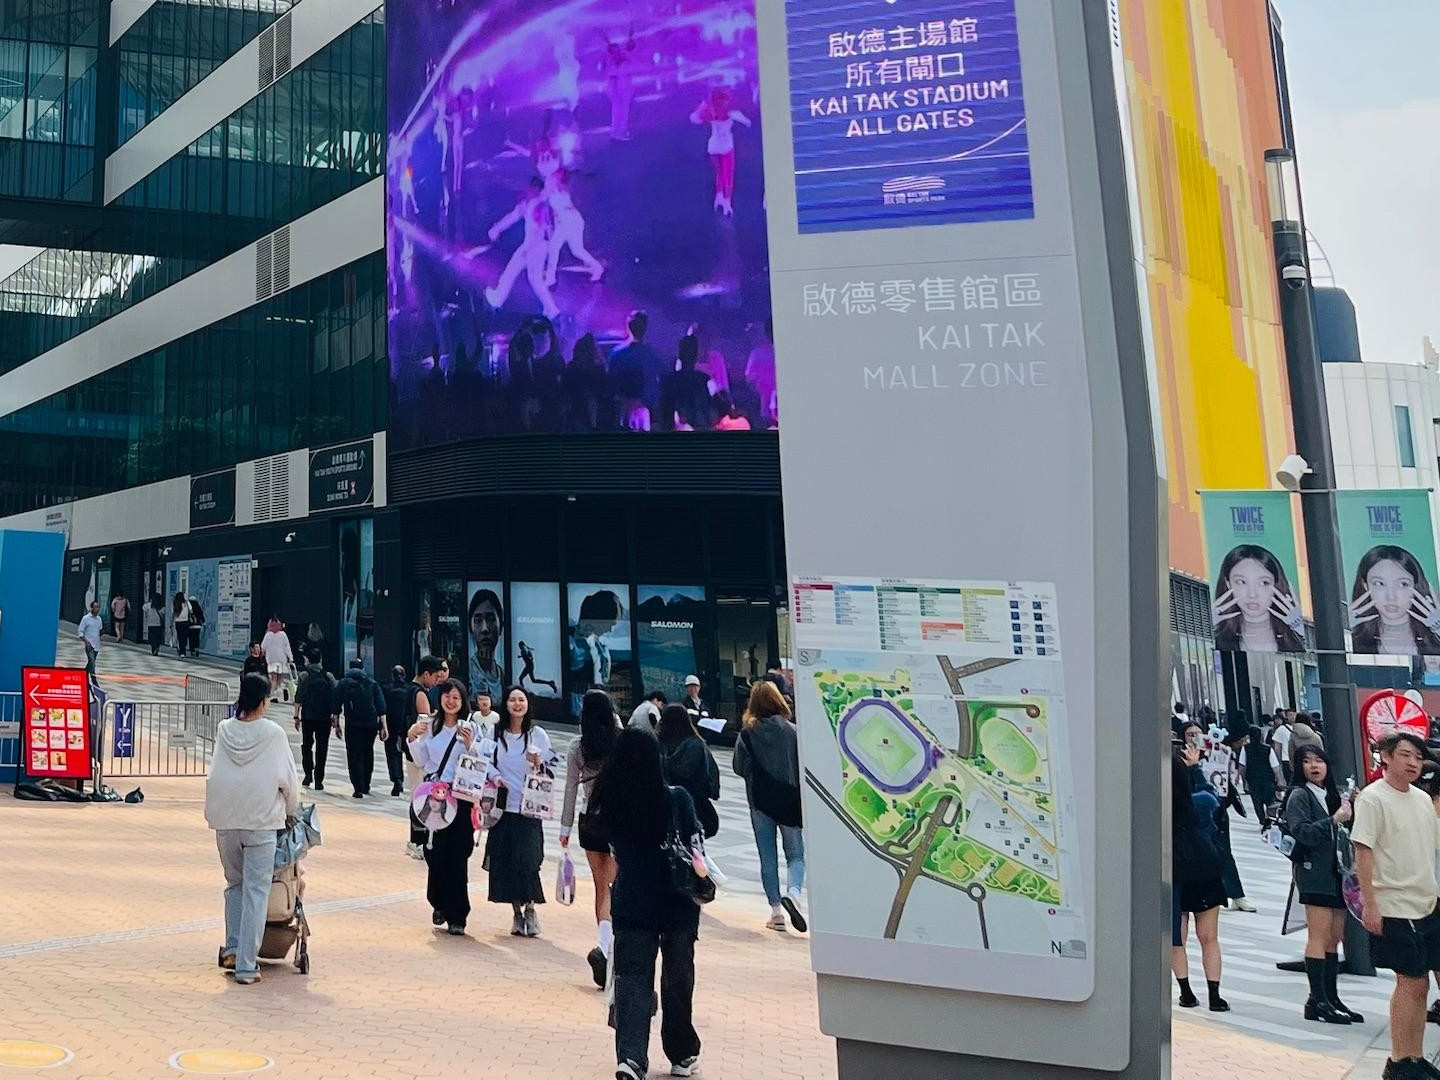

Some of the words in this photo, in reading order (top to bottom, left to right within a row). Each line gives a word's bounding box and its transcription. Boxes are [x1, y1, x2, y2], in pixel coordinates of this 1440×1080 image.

[827, 17, 978, 58] 啟德主場館
[845, 52, 965, 89] 所有閘口
[810, 95, 848, 117] KAI
[852, 91, 899, 112] TAK
[903, 79, 1009, 107] STADIUM
[845, 119, 892, 138] ALL
[896, 108, 975, 133] GATES
[802, 272, 1043, 316] 啟德零售館區
[917, 323, 972, 350] KAI
[980, 322, 1046, 348] TAK
[863, 364, 950, 390] MALL
[958, 361, 1049, 388] ZONE
[1229, 506, 1265, 523] TWICE
[1365, 505, 1402, 523] TWICE
[650, 620, 694, 629] SALOMON
